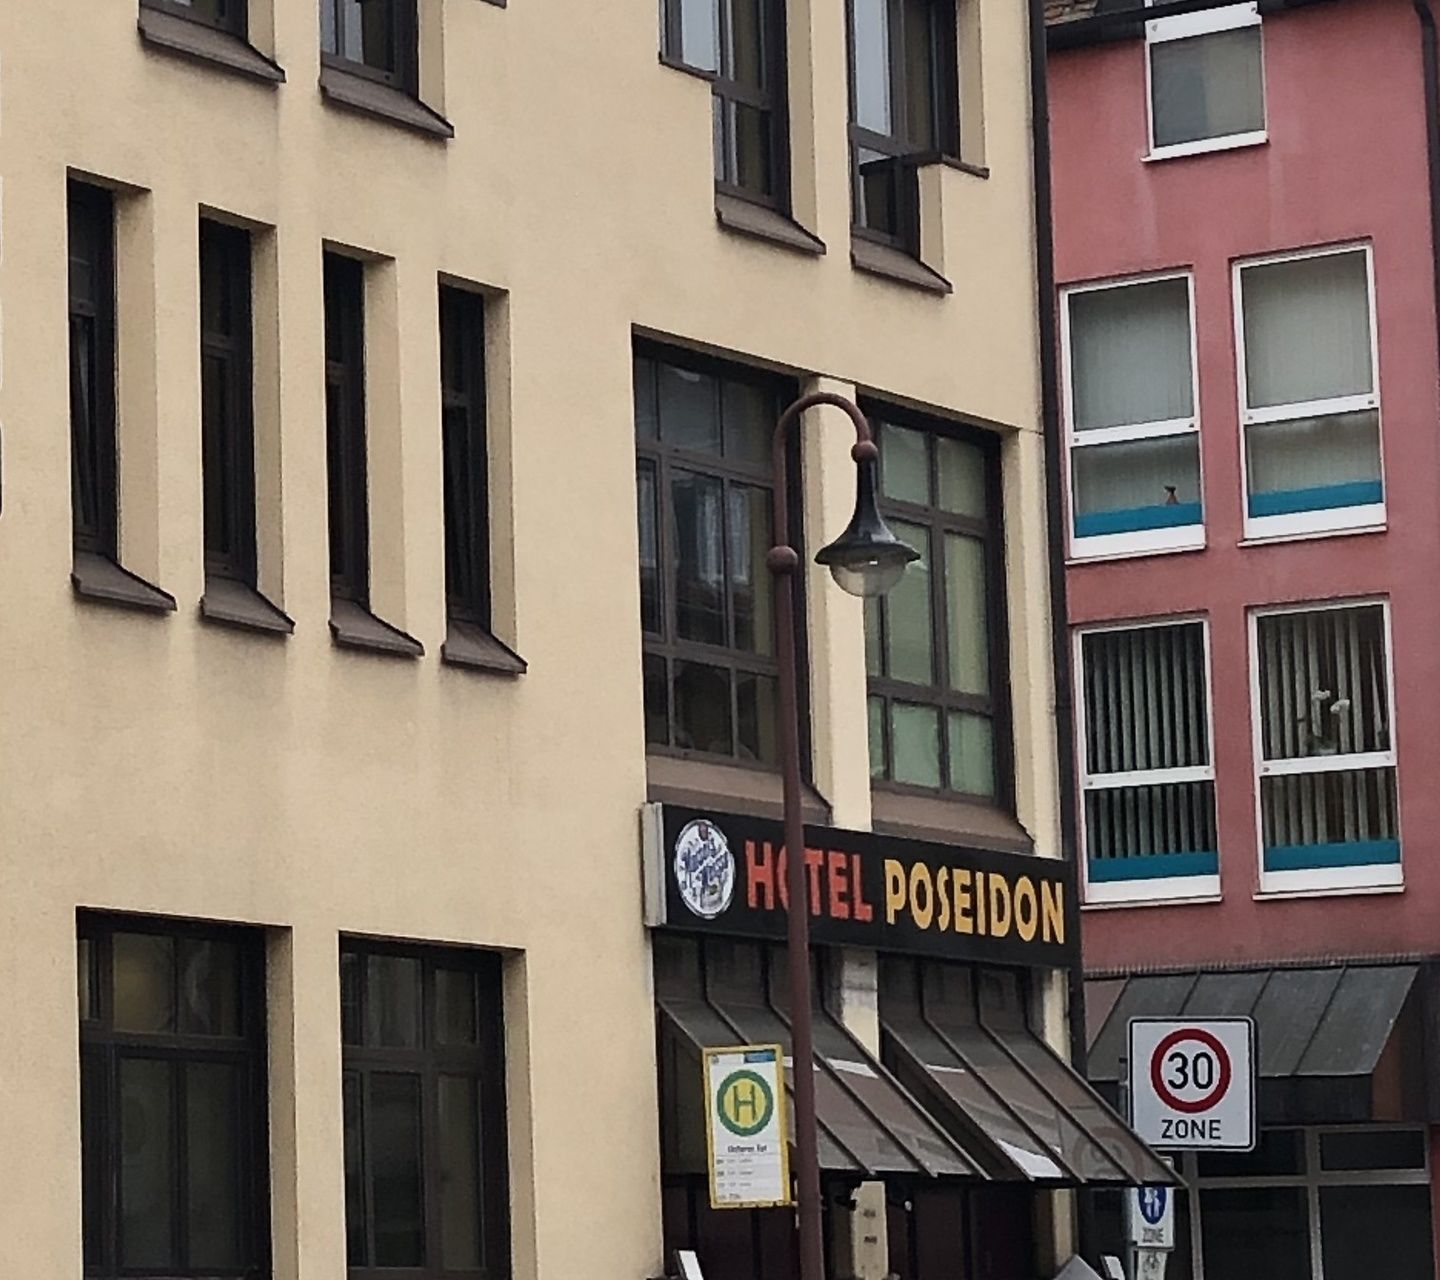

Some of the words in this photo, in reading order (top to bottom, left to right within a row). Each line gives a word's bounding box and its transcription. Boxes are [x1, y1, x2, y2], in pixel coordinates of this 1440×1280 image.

[884, 858, 1066, 945] POSEIDON
[1167, 1051, 1214, 1090] 30
[1161, 1118, 1222, 1140] ZONE
